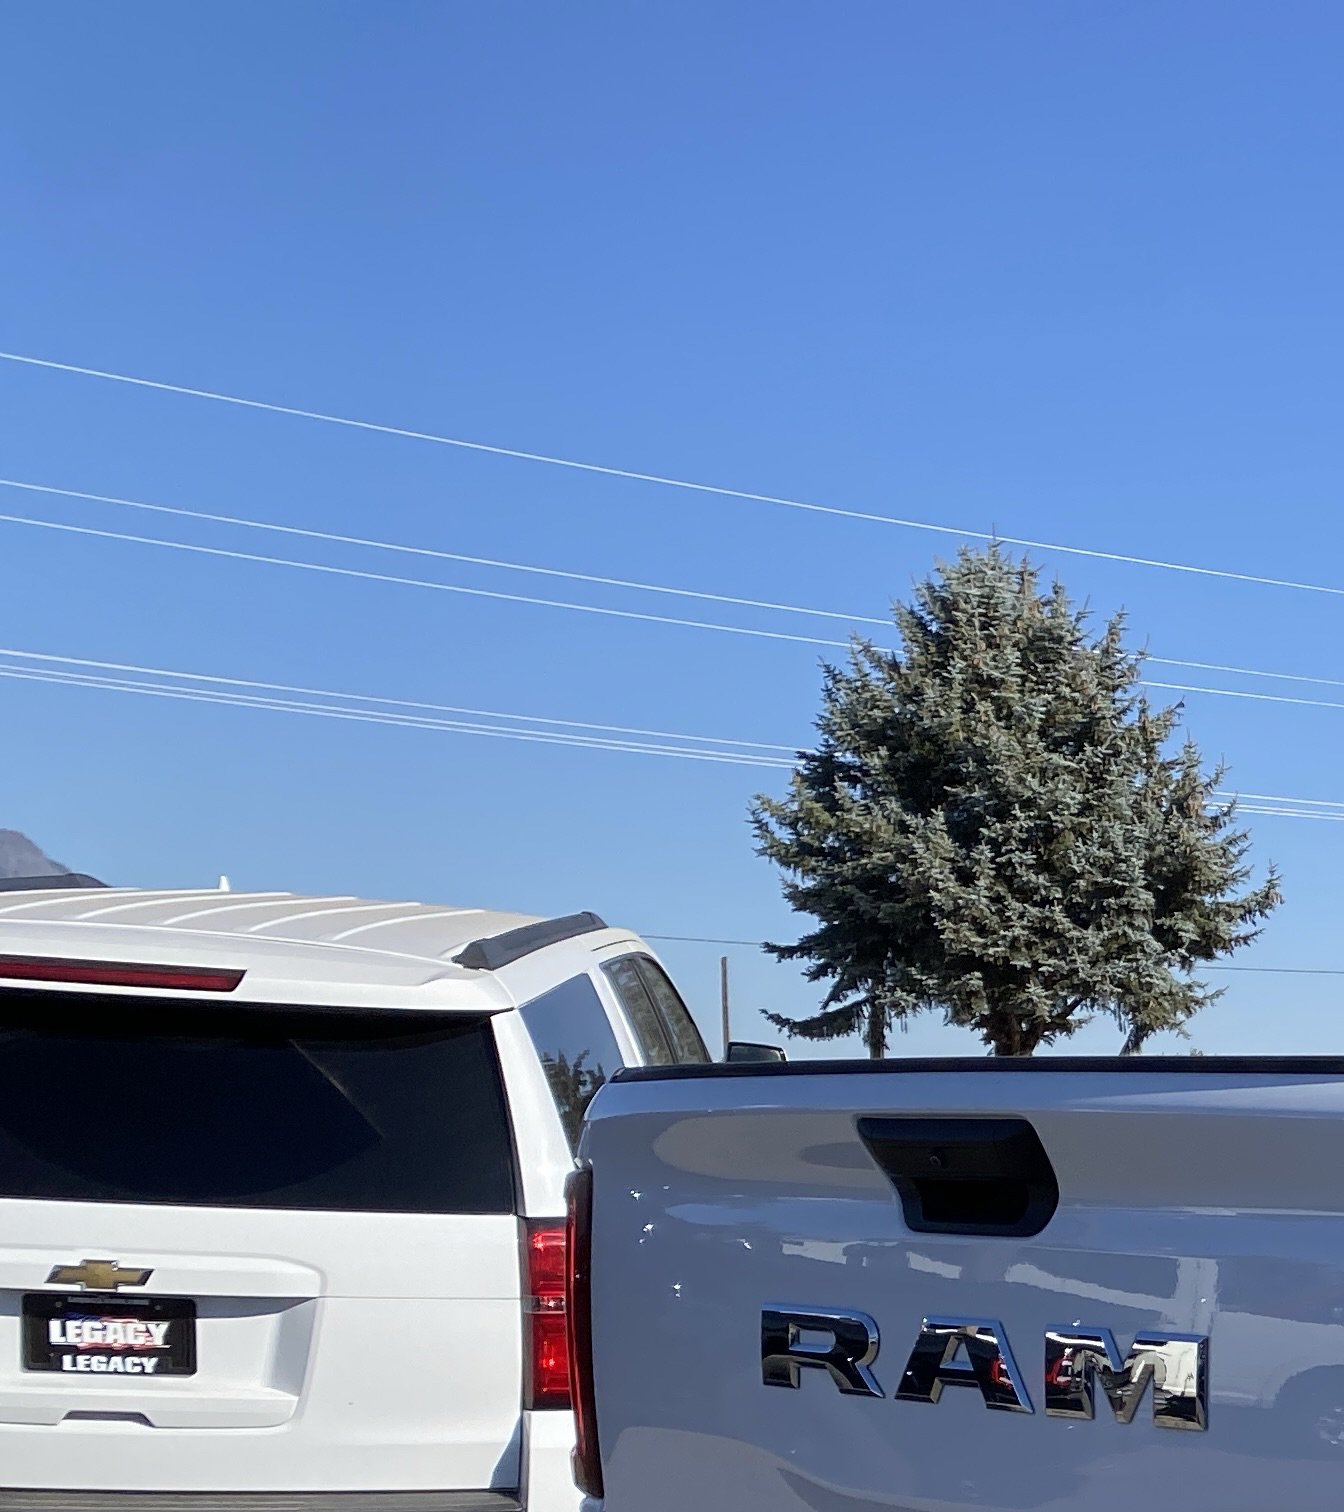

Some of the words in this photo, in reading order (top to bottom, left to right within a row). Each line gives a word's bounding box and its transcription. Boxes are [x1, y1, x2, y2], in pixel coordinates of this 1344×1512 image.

[49, 1319, 171, 1346] LEGACY
[61, 1354, 160, 1374] LEGACY
[760, 1302, 1209, 1432] RAM
